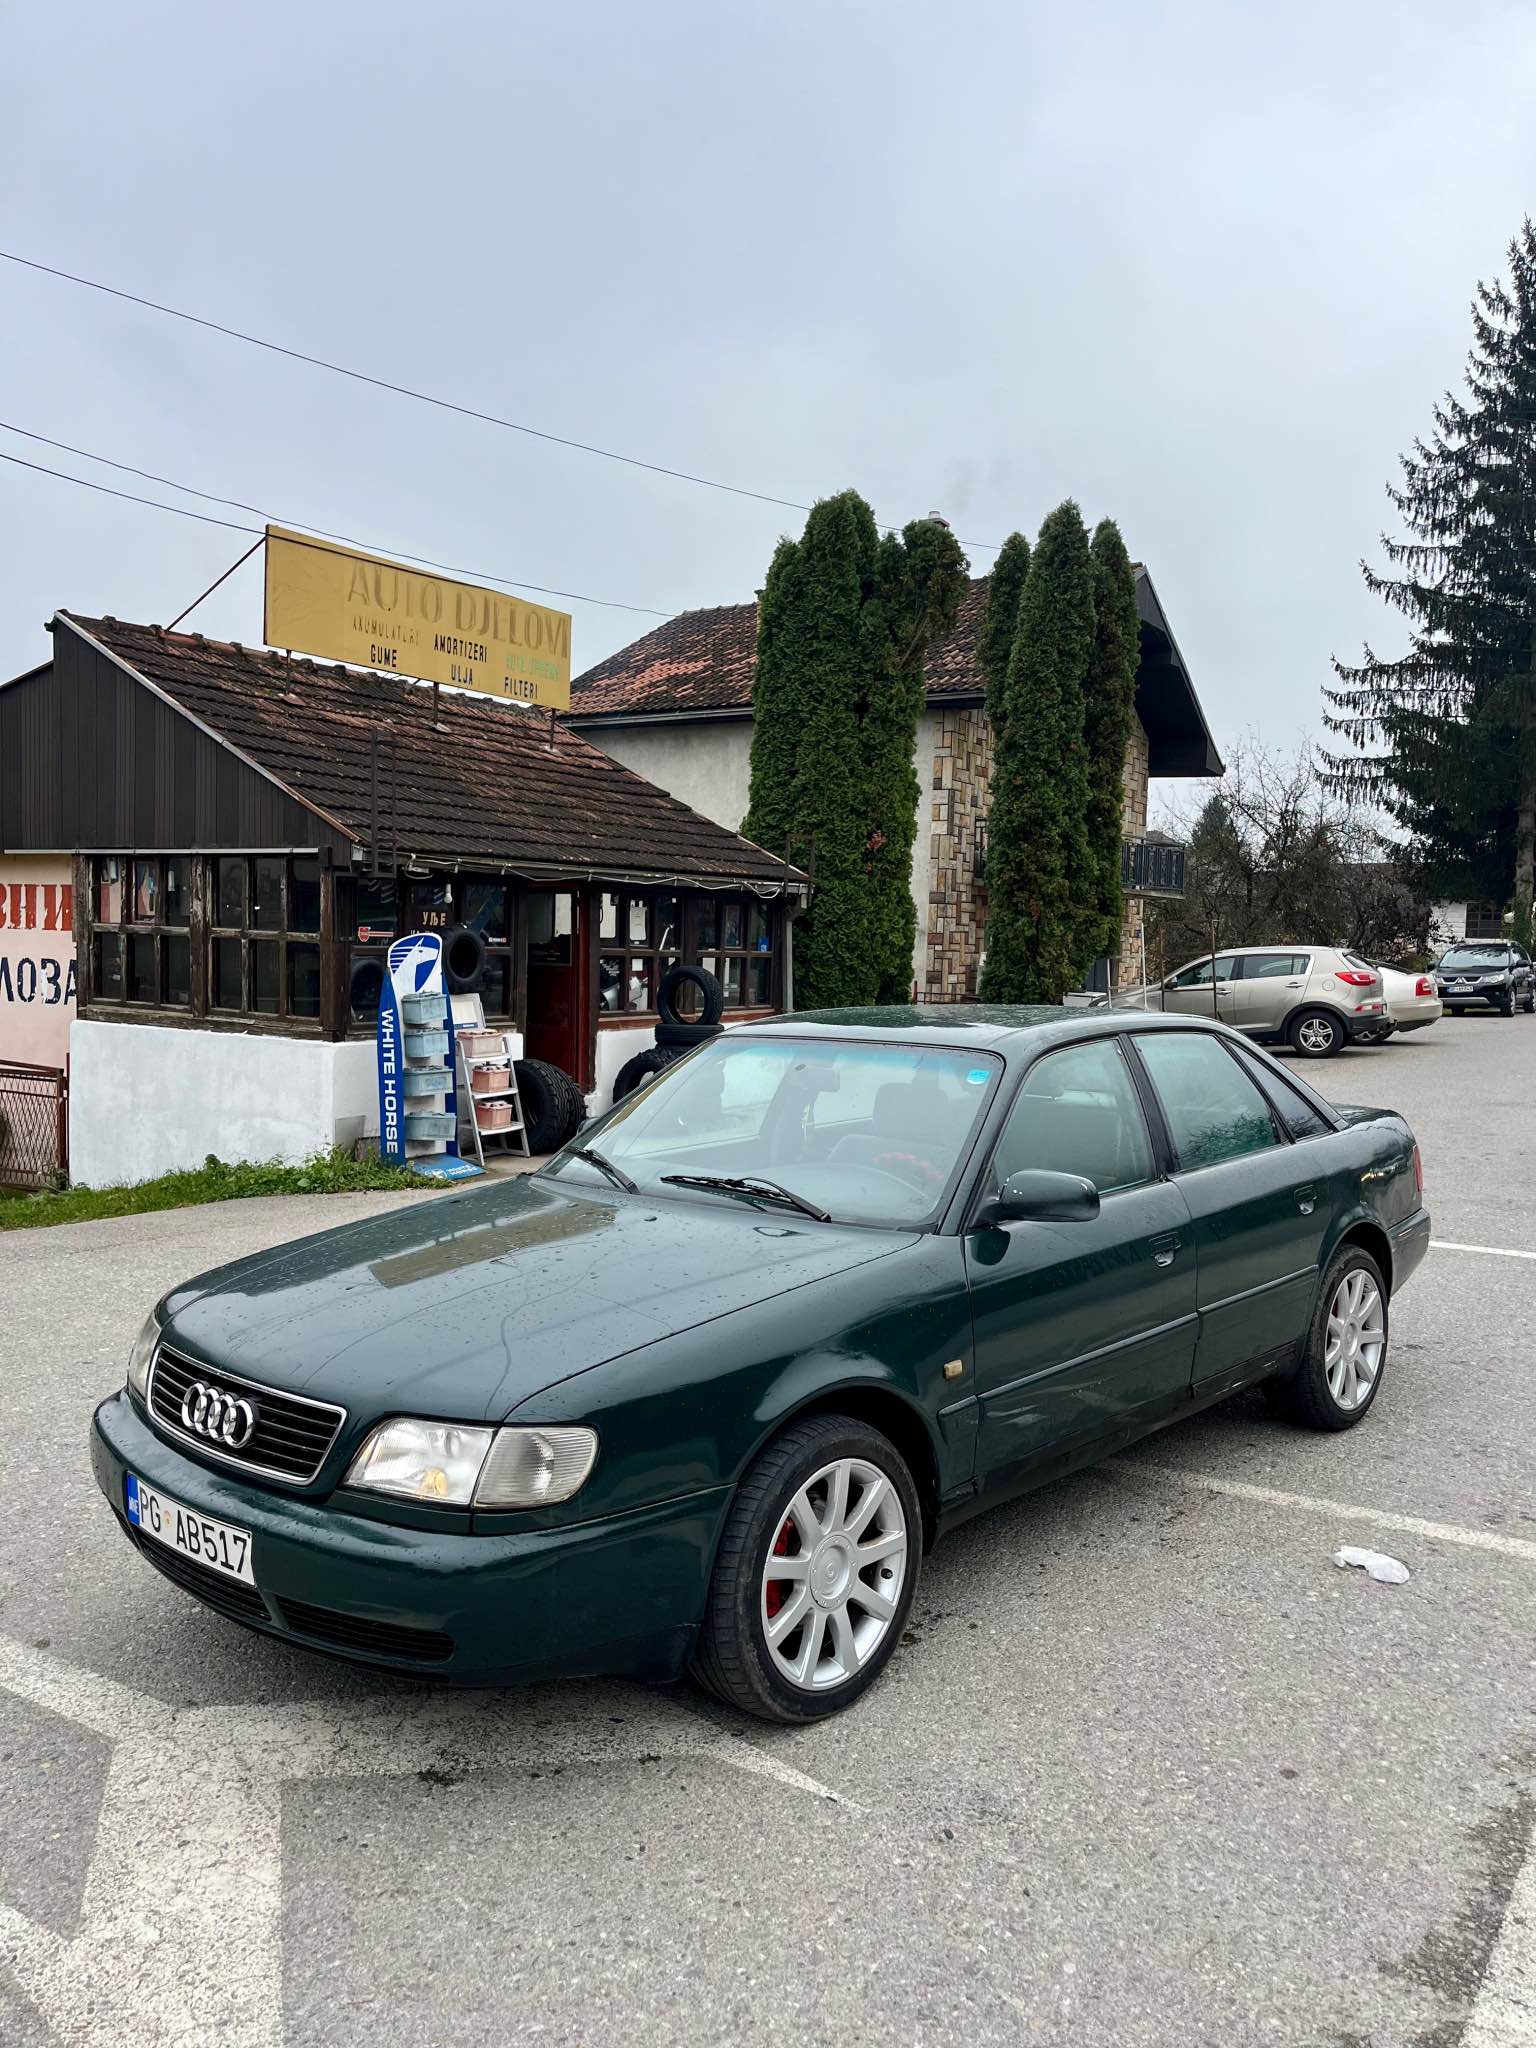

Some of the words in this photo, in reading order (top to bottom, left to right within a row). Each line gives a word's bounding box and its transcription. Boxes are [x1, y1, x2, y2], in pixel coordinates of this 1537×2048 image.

[347, 562, 443, 624] AUTO
[455, 590, 568, 659] DJELOVI
[370, 644, 398, 668] GUME
[451, 663, 473, 686] ULJA
[504, 676, 538, 700] FILTERI
[433, 633, 488, 664] AMORTIZERI
[381, 1008, 396, 1075] WHITE
[384, 1079, 399, 1154] HORSE
[139, 1485, 162, 1533] PG
[176, 1509, 247, 1574] AB517
